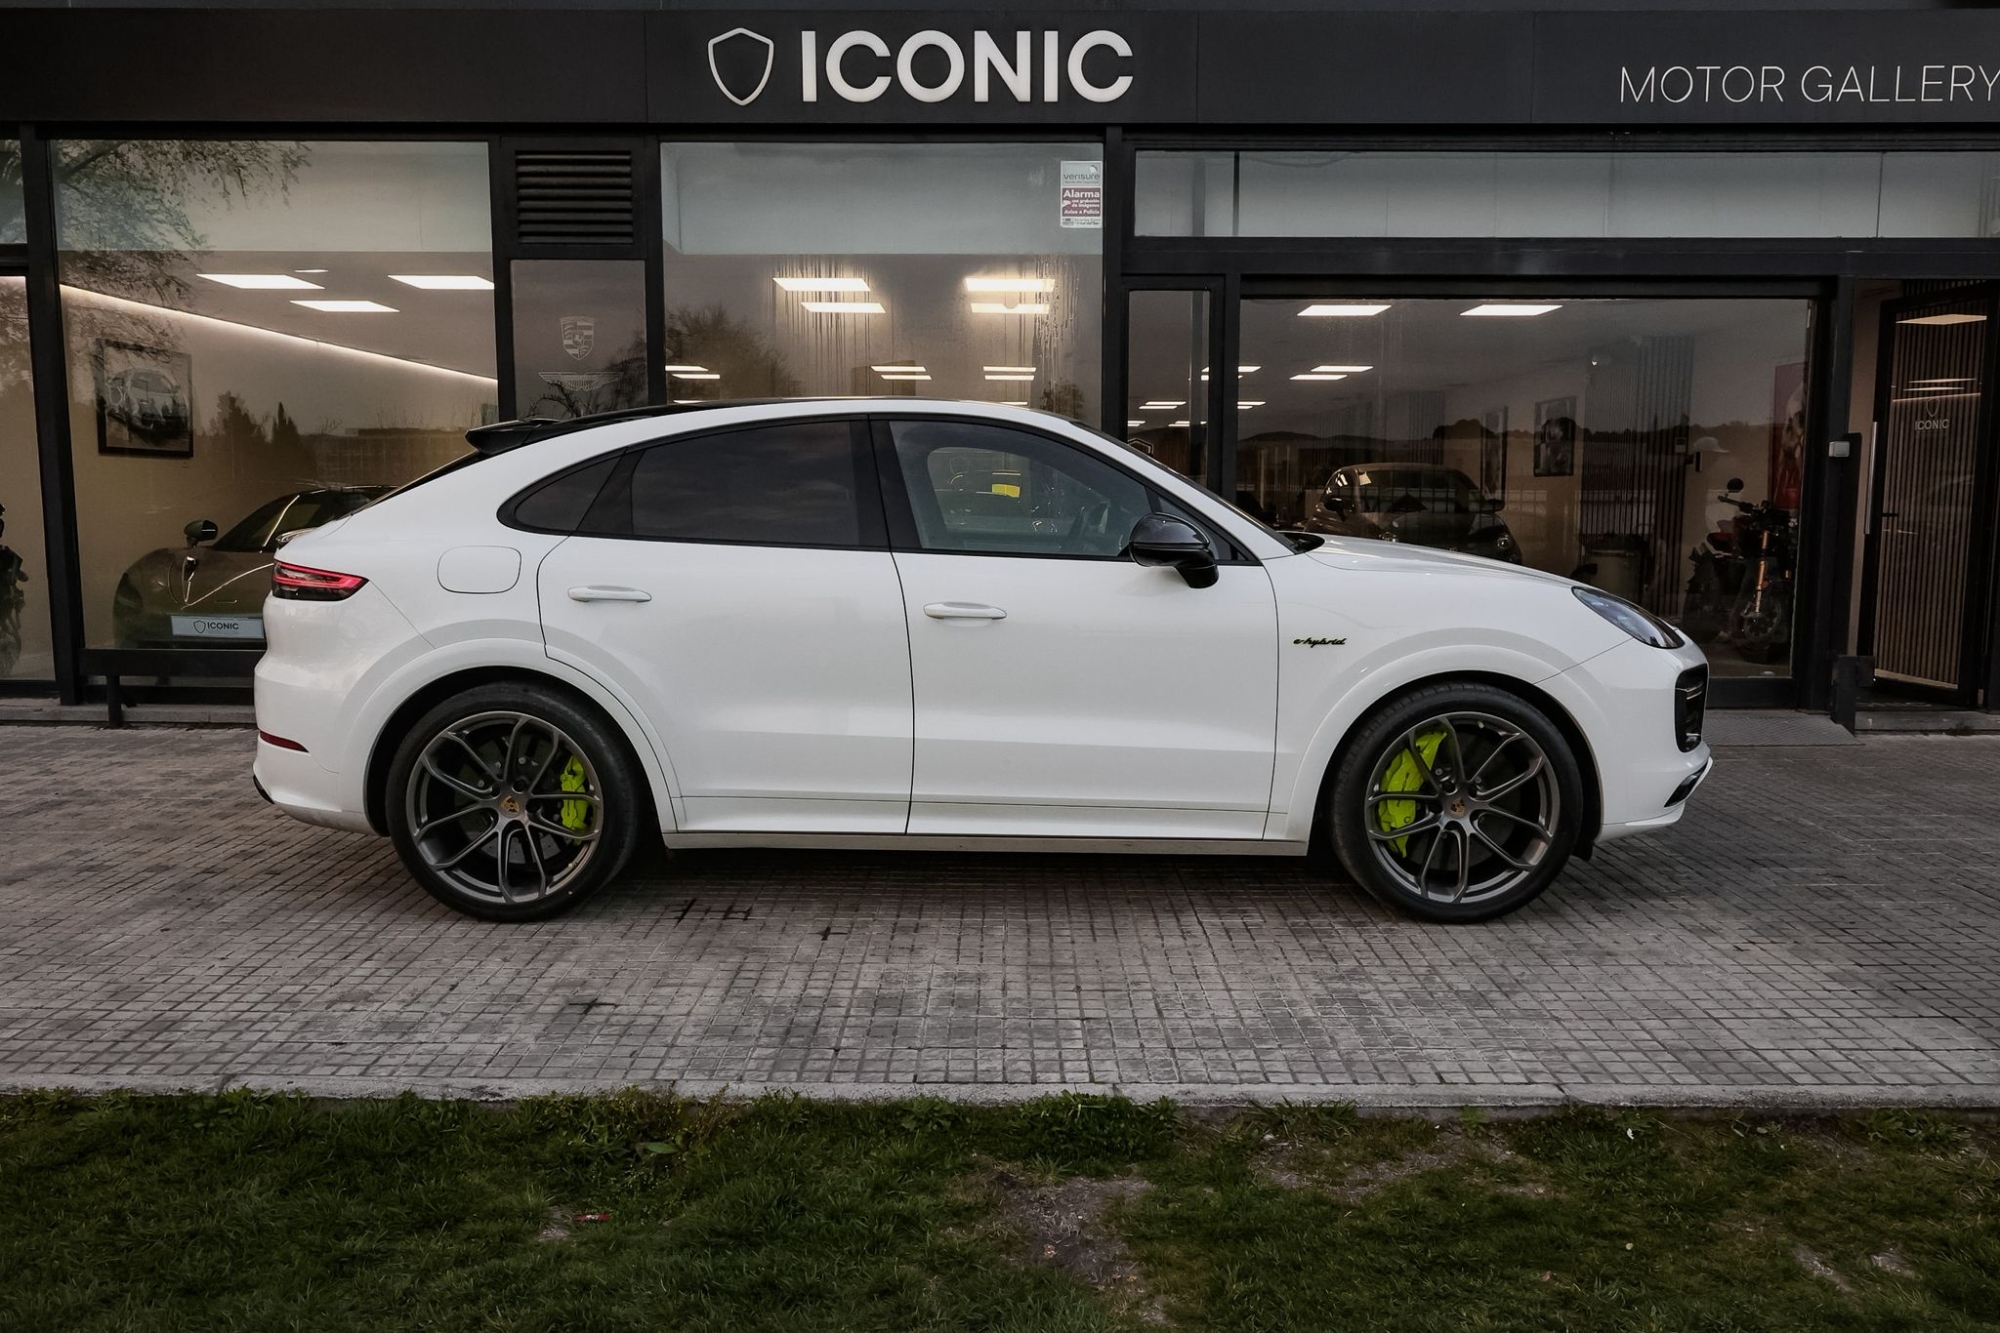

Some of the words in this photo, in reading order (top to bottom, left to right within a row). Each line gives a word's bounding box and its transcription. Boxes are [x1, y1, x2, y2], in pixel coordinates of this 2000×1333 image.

[801, 29, 1134, 103] ICONIC
[1620, 65, 1786, 103] MOTOR
[1800, 65, 2000, 103] GALLERY
[1063, 189, 1100, 198] Alarma
[1915, 419, 1949, 430] ICONIC
[207, 622, 239, 630] ICONIC
